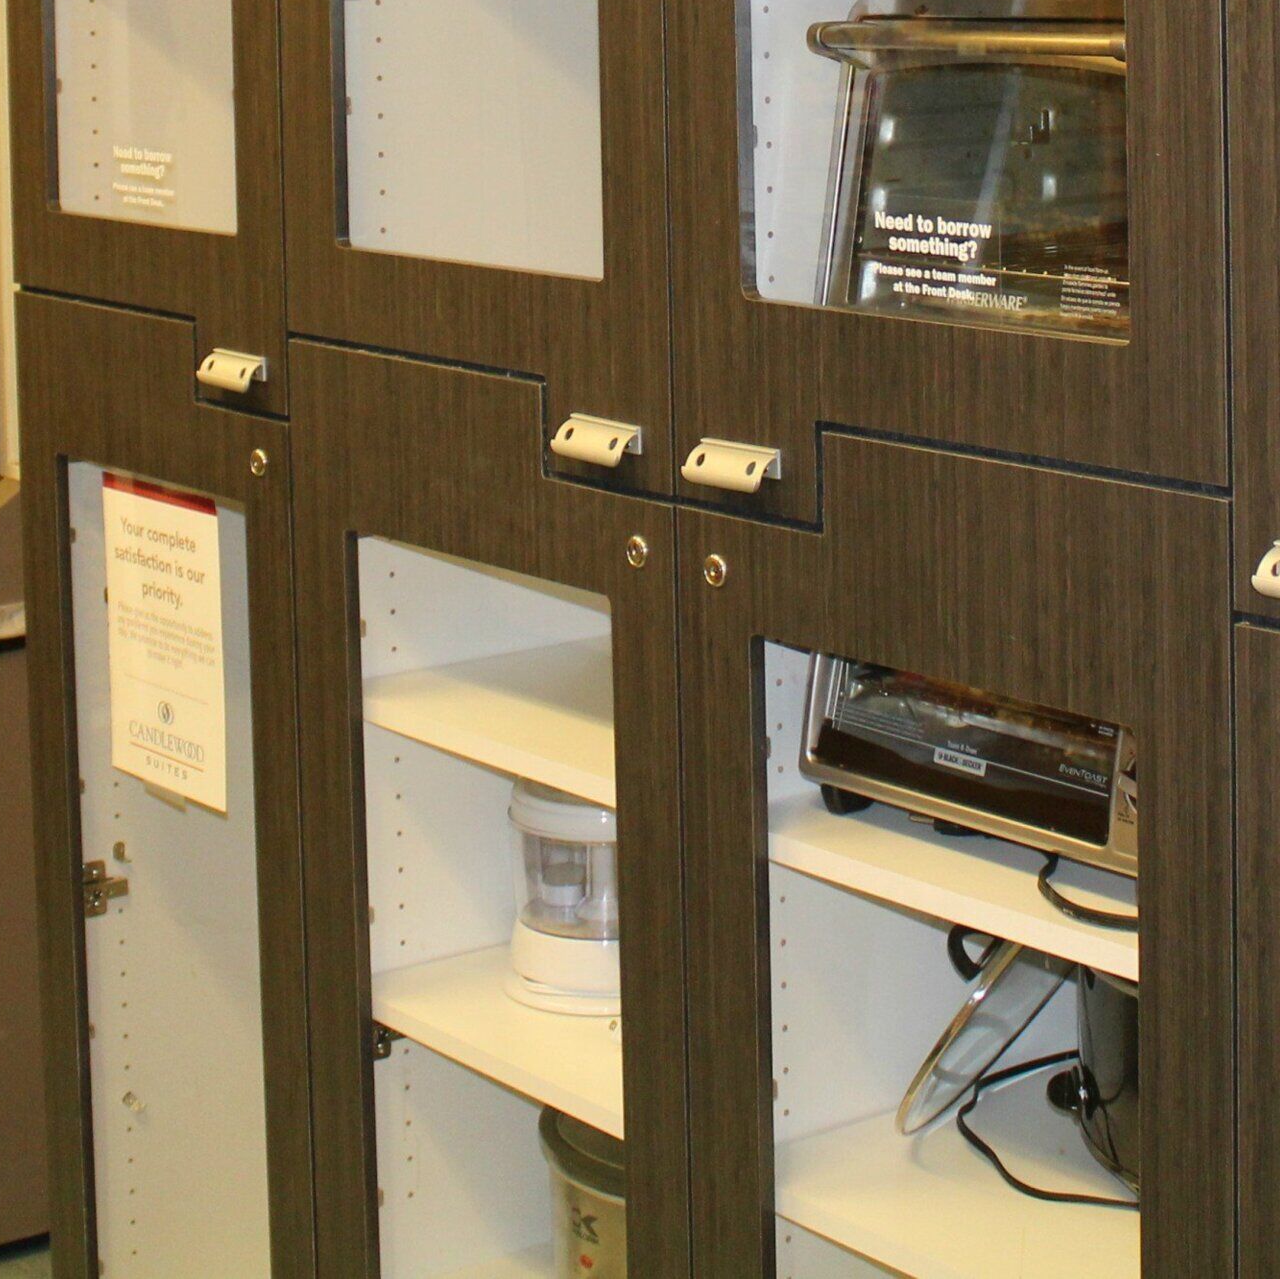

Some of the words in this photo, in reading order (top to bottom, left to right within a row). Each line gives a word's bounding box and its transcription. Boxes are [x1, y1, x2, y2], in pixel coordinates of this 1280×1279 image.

[874, 210, 914, 233] Need
[917, 213, 934, 234] to
[937, 215, 993, 240] borrow
[888, 236, 978, 261] something?
[873, 263, 903, 278] Please
[905, 267, 922, 279] see
[932, 268, 956, 283] team
[958, 270, 997, 287] member
[893, 280, 903, 292] at
[904, 281, 920, 294] the
[922, 283, 947, 298] Front
[120, 517, 145, 541] Your
[147, 525, 197, 554] complete
[114, 546, 173, 575] satisfaction
[175, 560, 184, 577] is
[187, 567, 206, 586] our
[142, 581, 183, 611] priority.
[129, 720, 206, 764] CANDLEWOOD
[146, 755, 189, 781] SUITES
